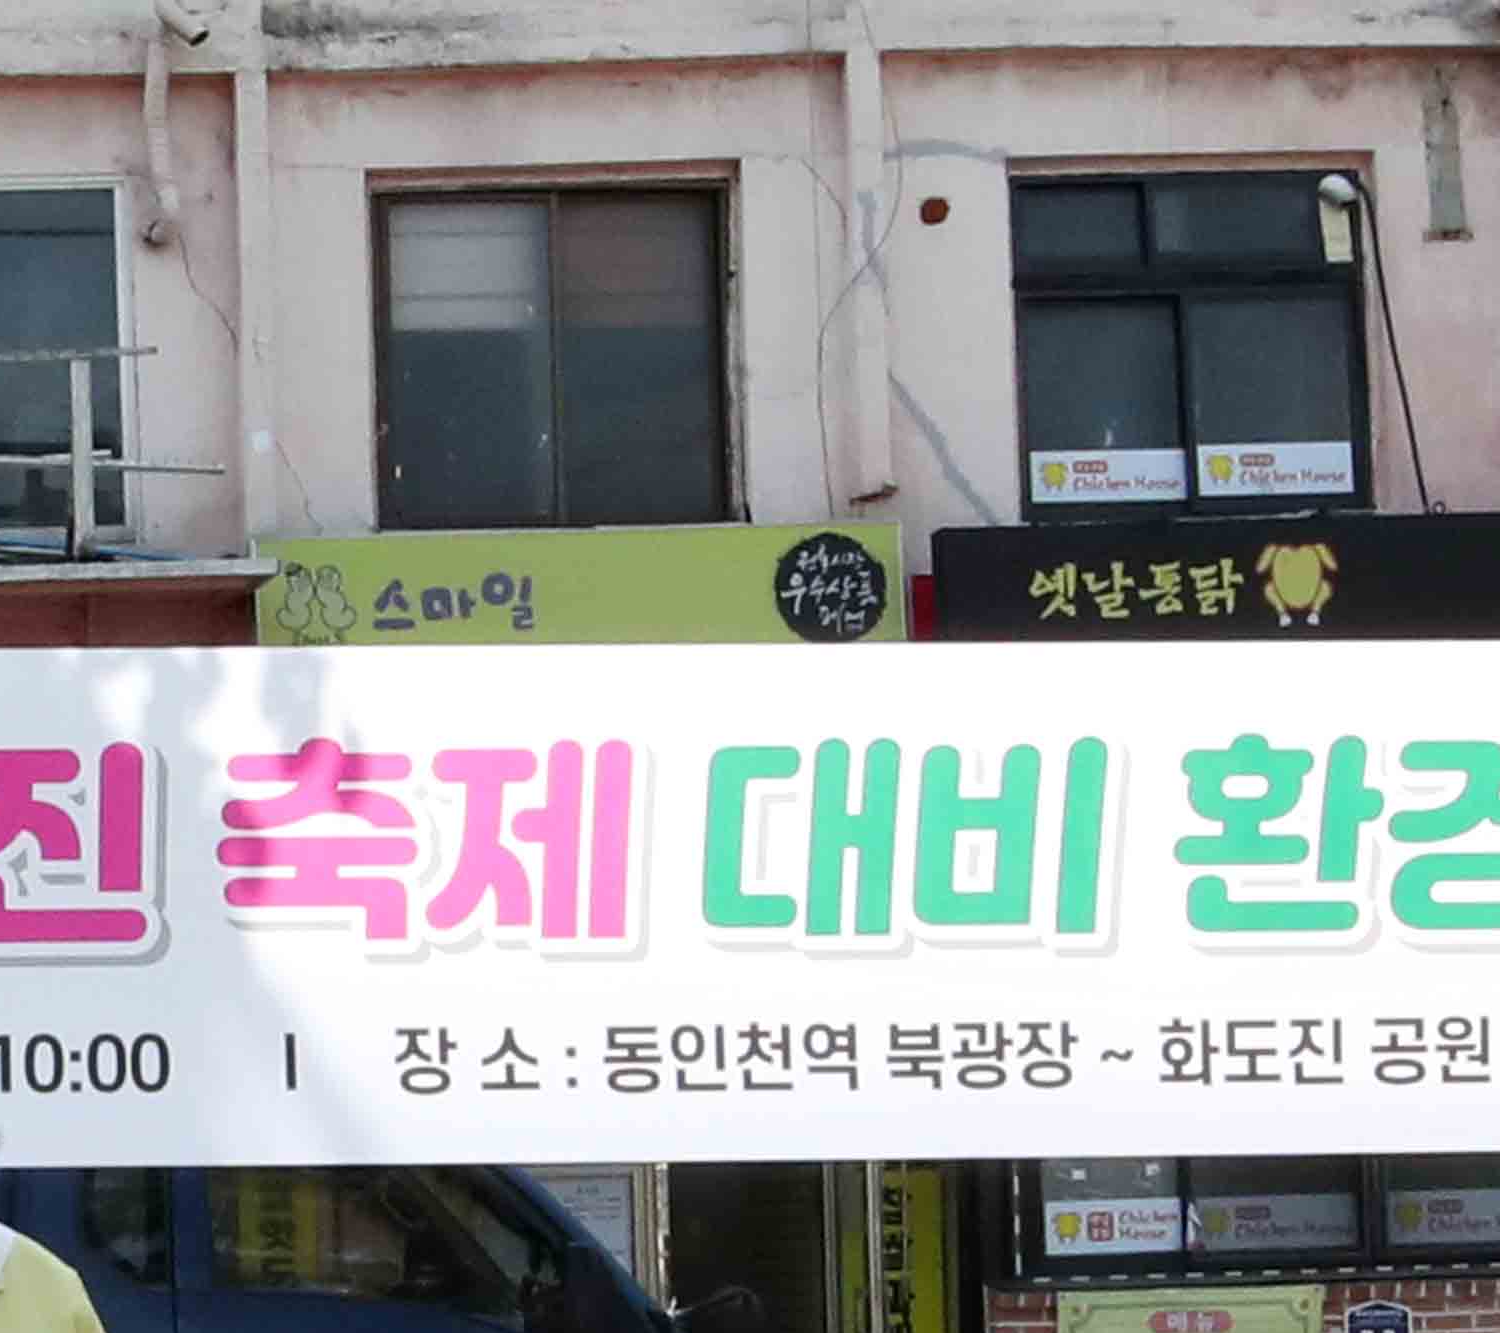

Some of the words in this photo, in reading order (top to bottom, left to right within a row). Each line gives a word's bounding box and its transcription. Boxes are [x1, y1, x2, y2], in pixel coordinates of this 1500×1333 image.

[373, 571, 536, 631] 스마일
[1028, 556, 1245, 620] 옛날통닭
[217, 738, 634, 940] 축제
[702, 736, 1108, 937] 대비
[602, 1022, 861, 1094] 동인천역
[885, 1020, 1078, 1091] 북광장
[1157, 1017, 1346, 1087] 화도진
[1369, 1015, 1493, 1086] 공원
